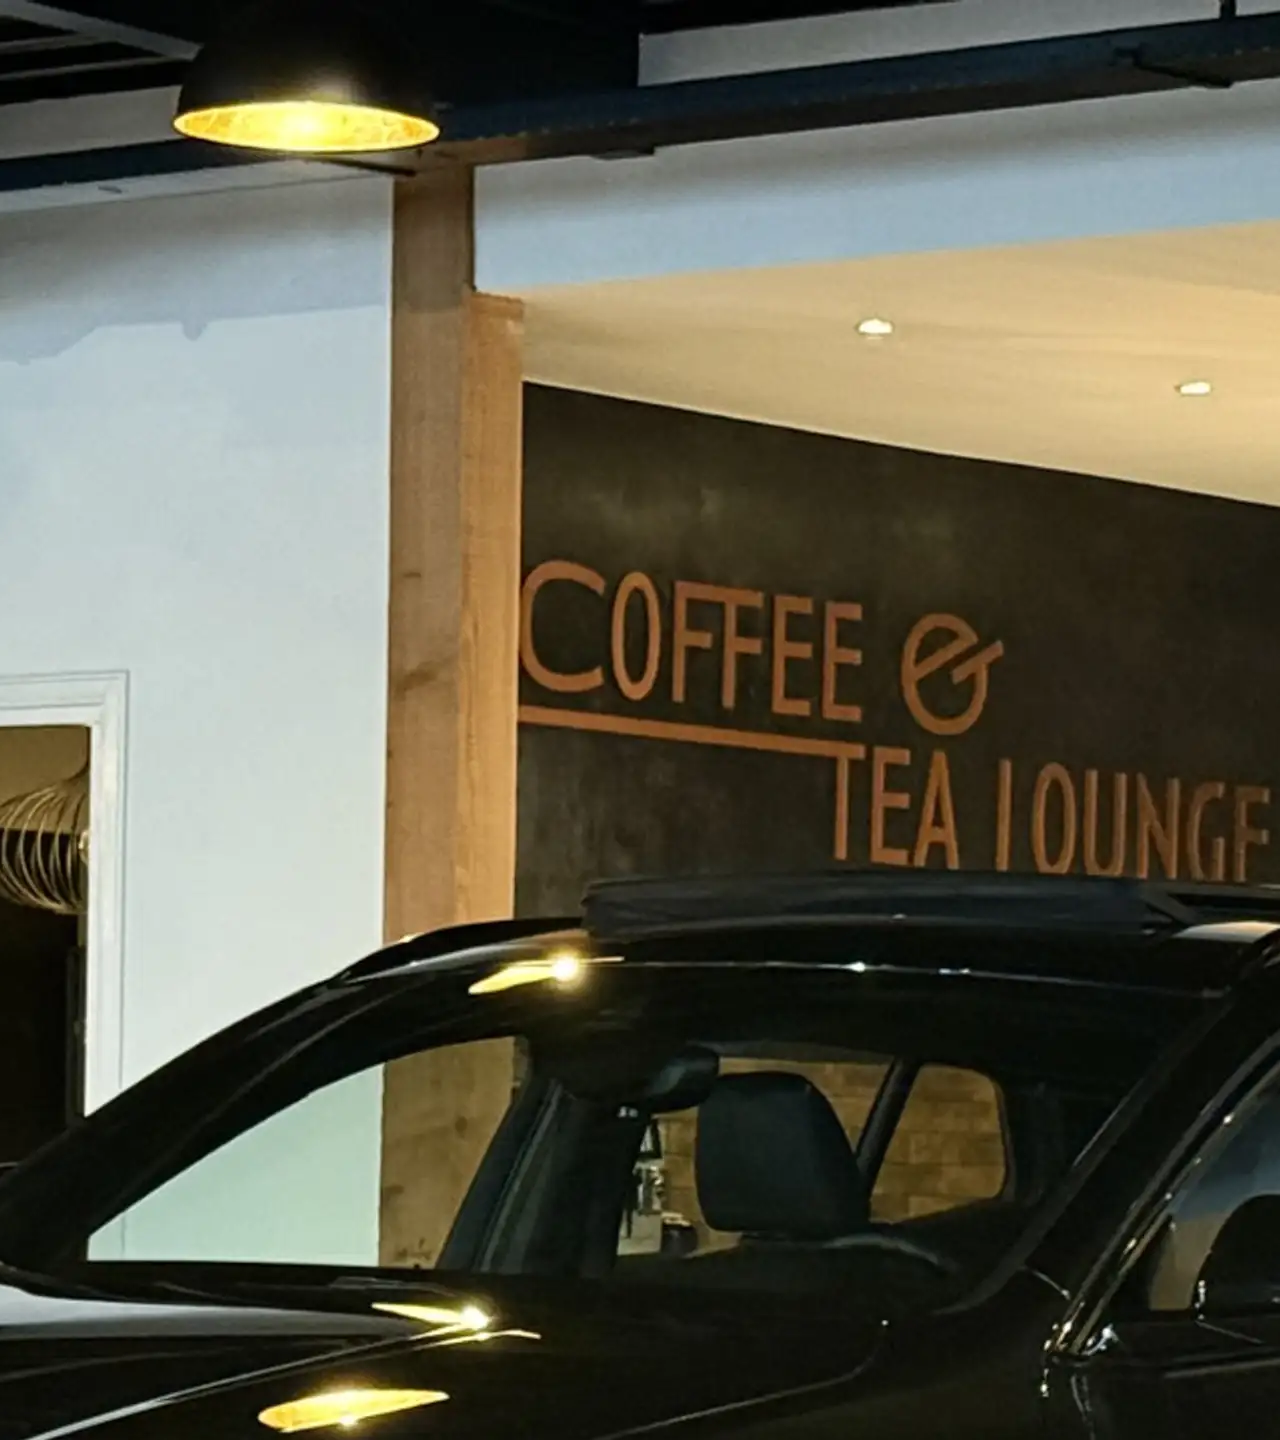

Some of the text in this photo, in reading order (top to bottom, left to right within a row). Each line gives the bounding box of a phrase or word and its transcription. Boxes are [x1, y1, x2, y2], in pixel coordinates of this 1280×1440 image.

[519, 559, 1005, 736] COFFEE &
[816, 743, 960, 870] TEA
